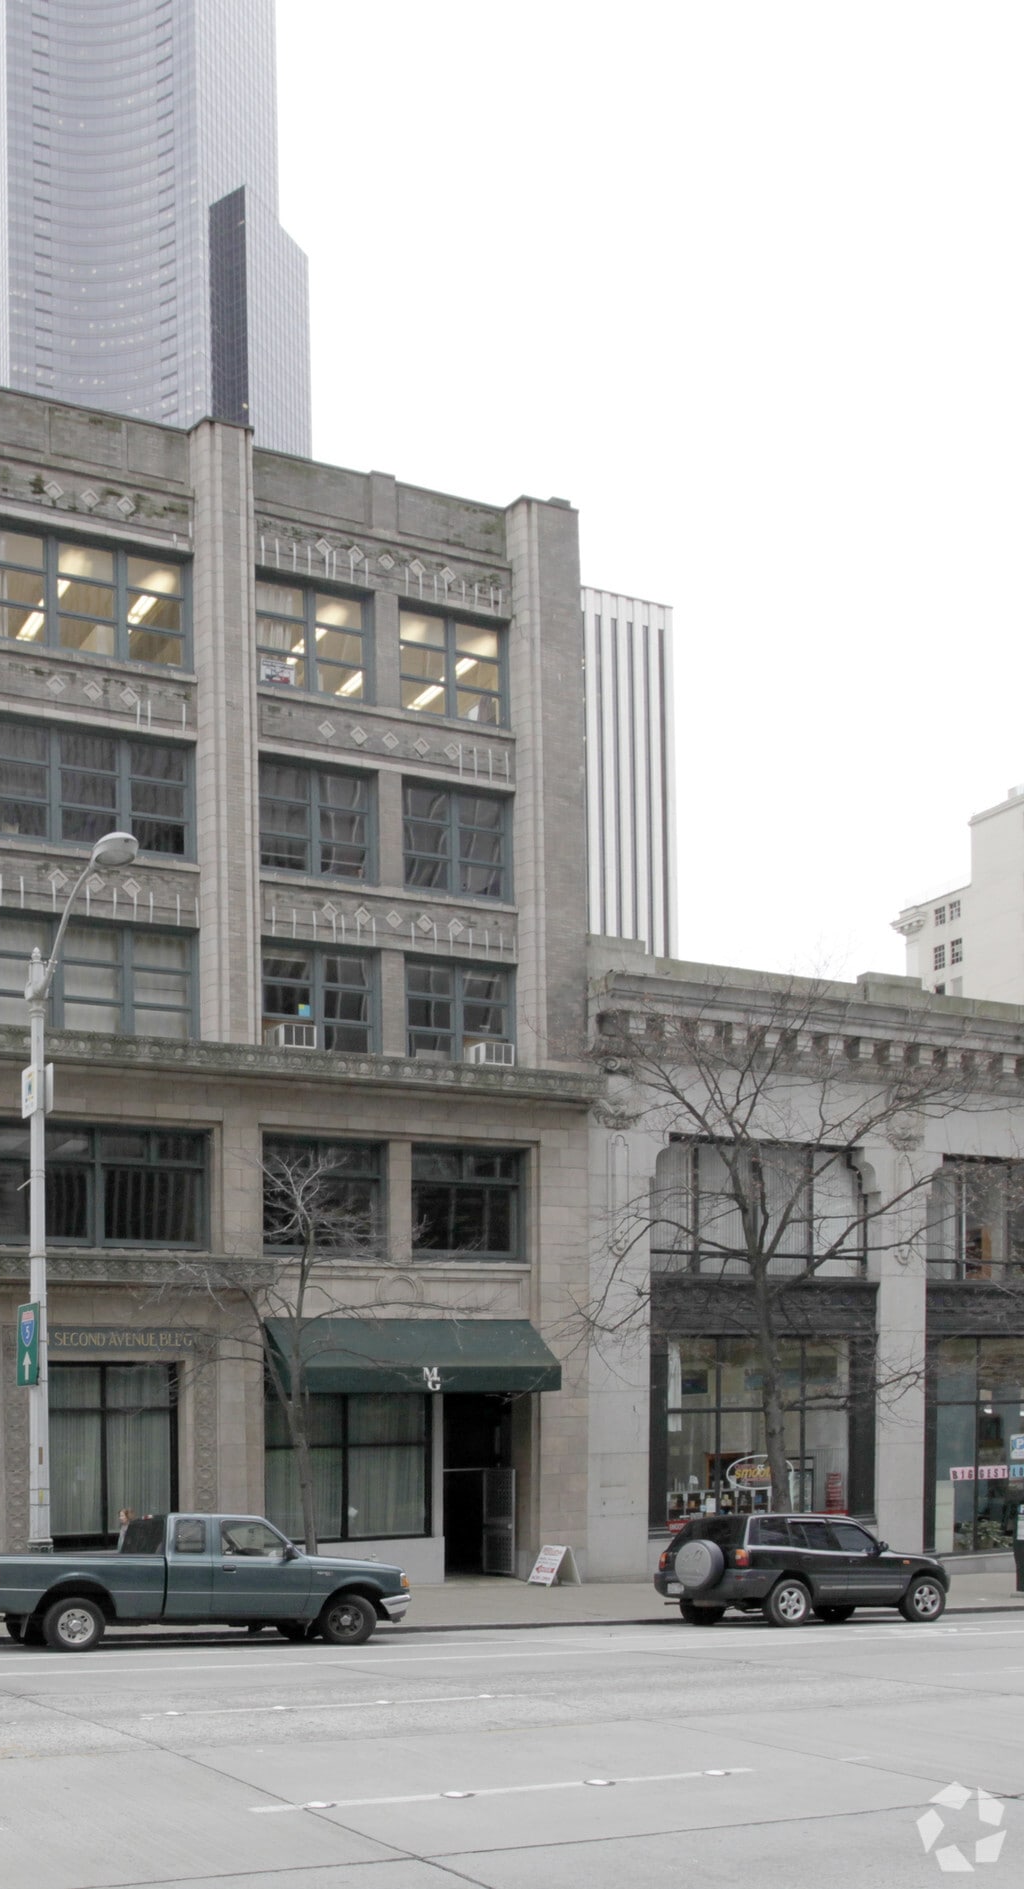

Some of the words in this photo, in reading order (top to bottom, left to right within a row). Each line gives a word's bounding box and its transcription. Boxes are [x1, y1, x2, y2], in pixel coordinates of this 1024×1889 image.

[26, 1325, 31, 1340] 5
[54, 1331, 106, 1347] SECOND
[108, 1332, 155, 1347] AVENUE
[951, 1468, 1007, 1480] BIGGEST
